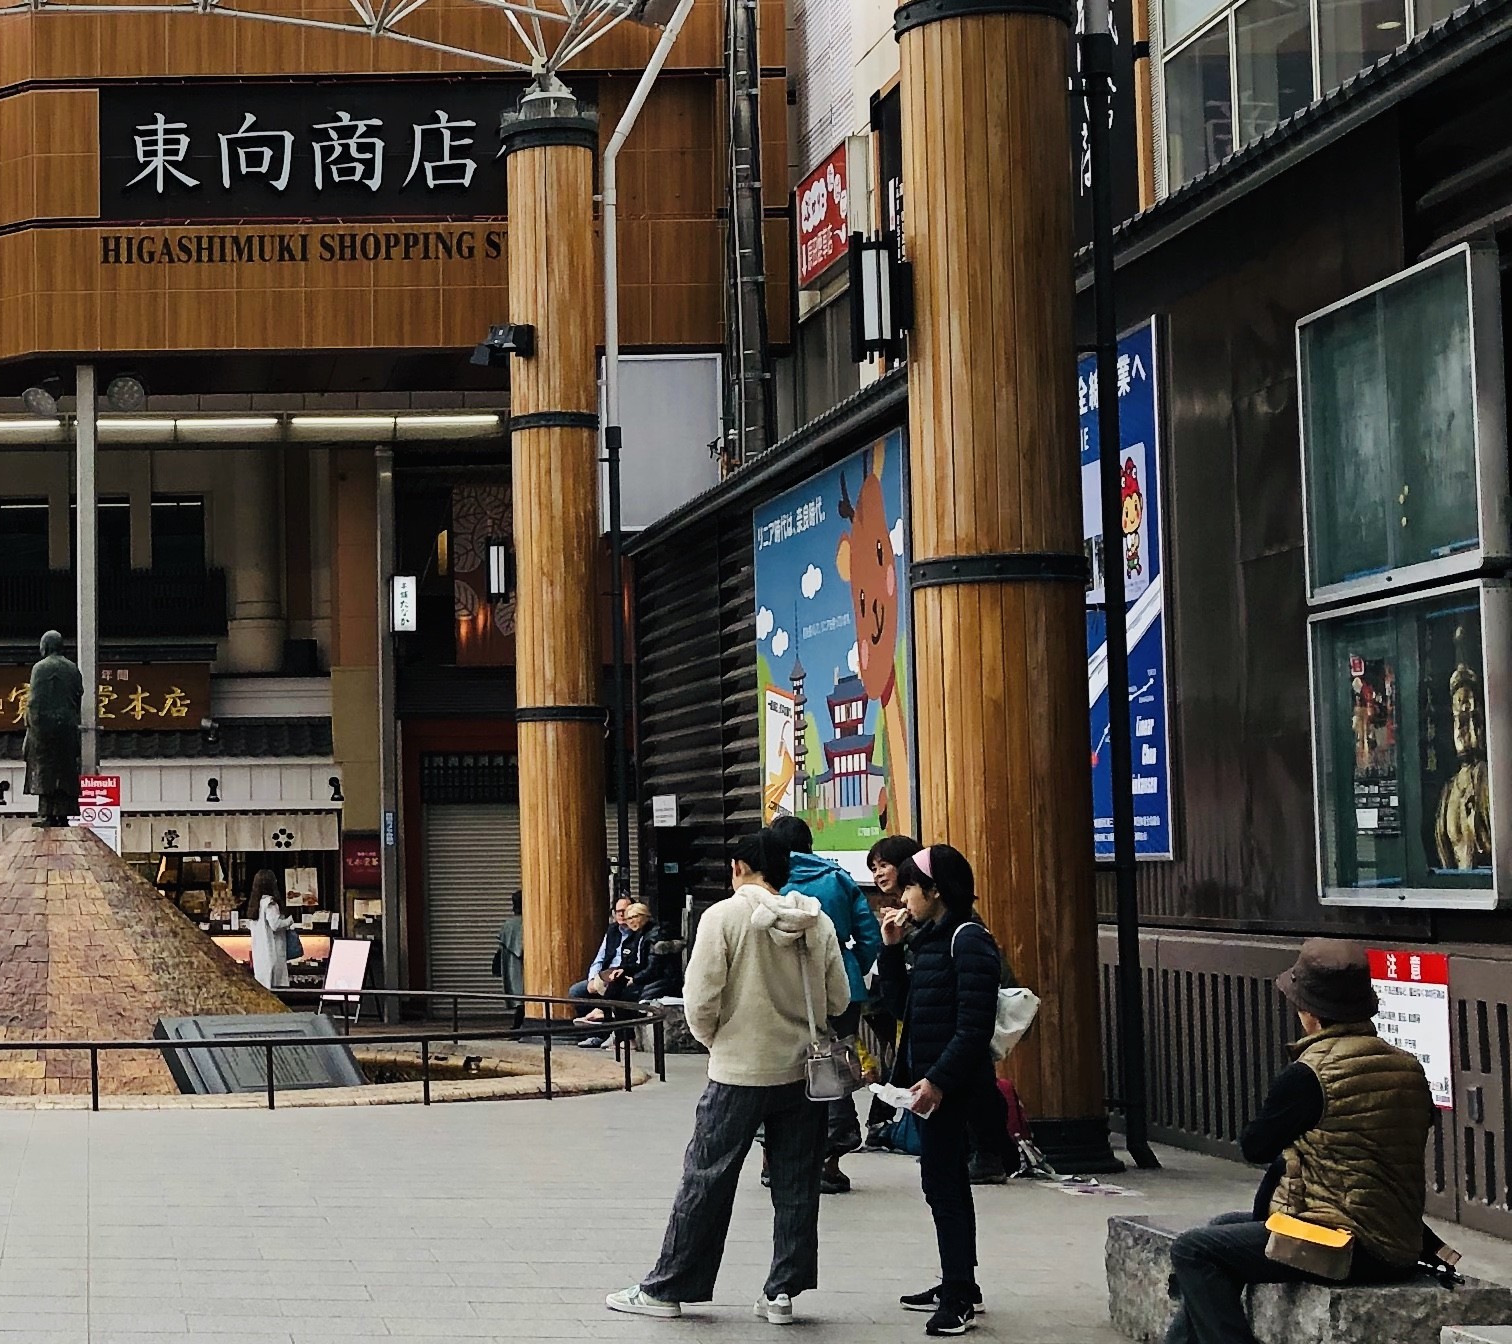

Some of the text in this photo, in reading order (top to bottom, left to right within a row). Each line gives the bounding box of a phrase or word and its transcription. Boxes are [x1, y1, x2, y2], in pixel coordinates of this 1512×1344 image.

[126, 110, 506, 194] 東向商店
[101, 230, 508, 265] HIGASHIMUKI SHOPPING S
[1387, 953, 1422, 980] 注意
